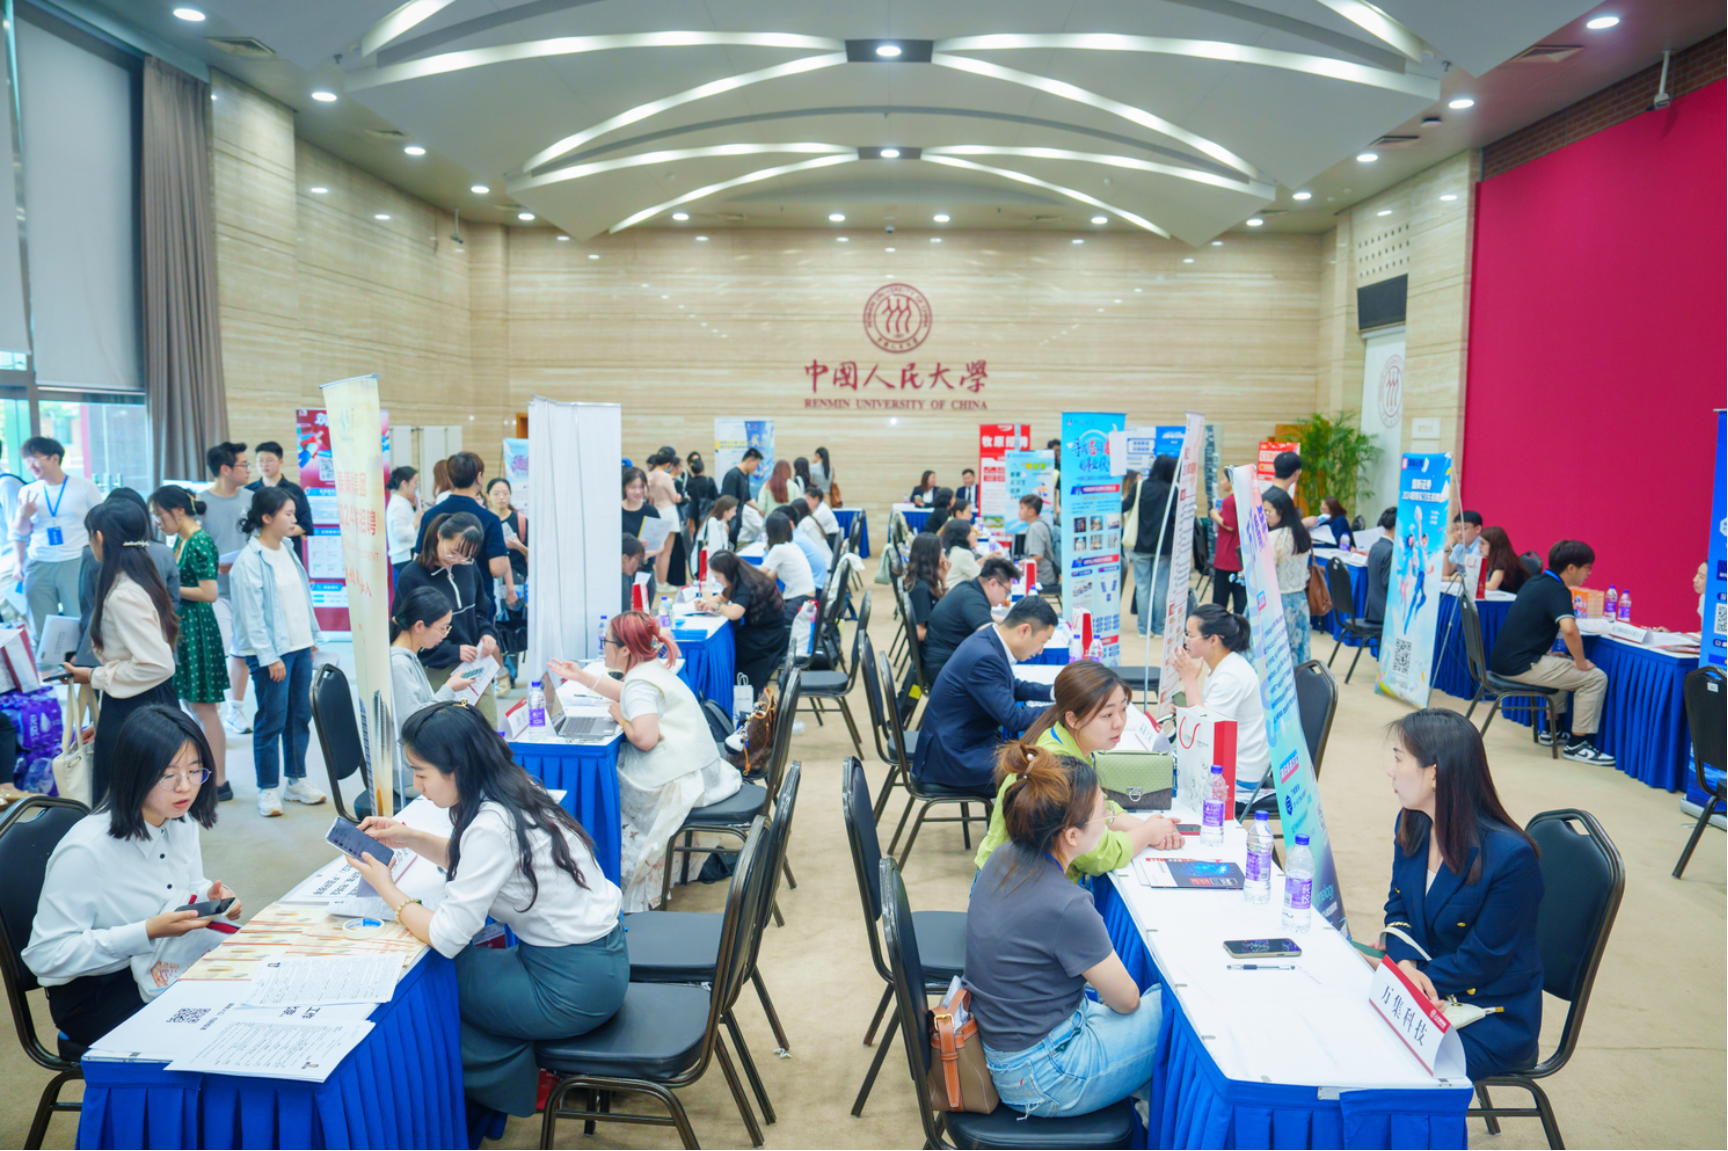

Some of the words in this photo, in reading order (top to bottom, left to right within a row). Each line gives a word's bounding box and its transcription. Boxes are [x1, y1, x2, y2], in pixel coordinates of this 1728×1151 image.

[804, 398, 850, 409] RENMIN
[856, 398, 925, 409] UNIVERSITY
[931, 398, 946, 409] OF
[951, 398, 988, 409] CHINA
[1381, 984, 1427, 1046] 万集科技
